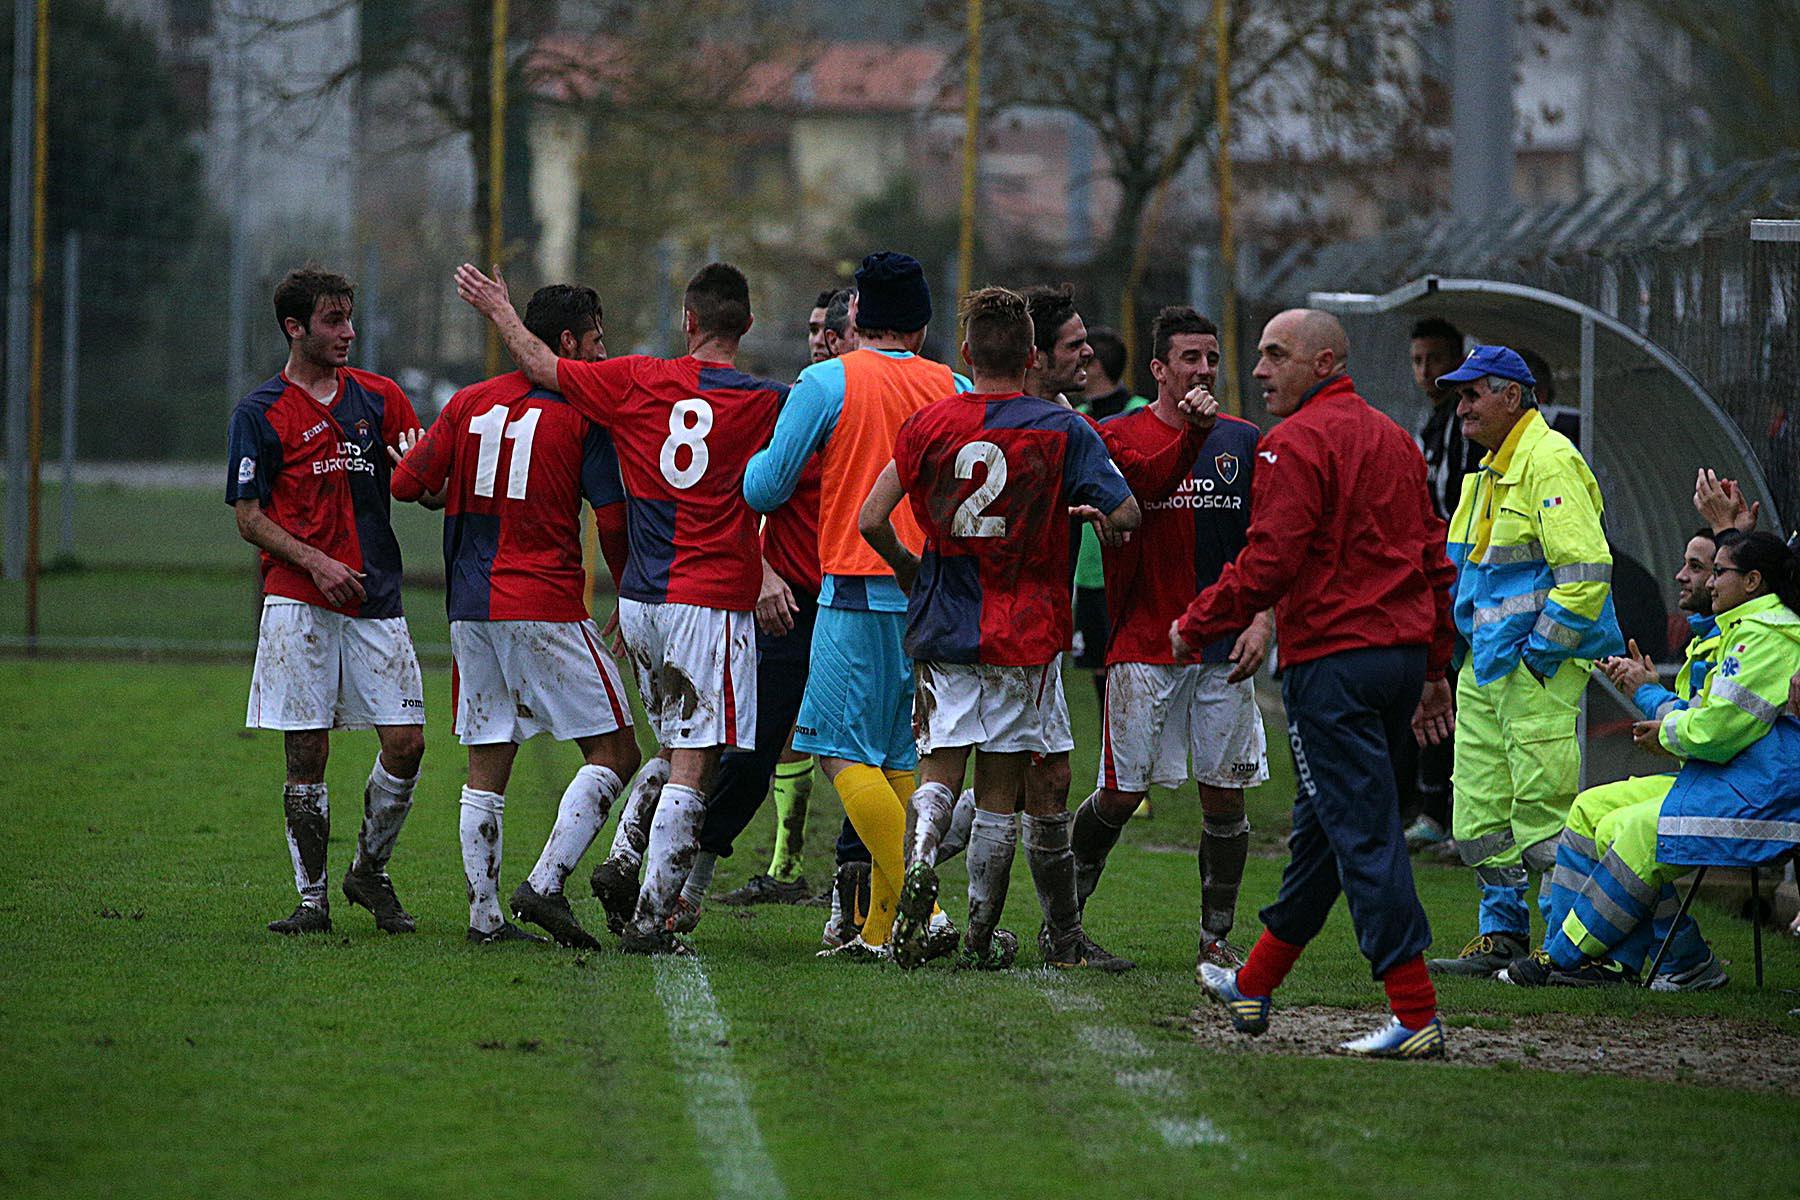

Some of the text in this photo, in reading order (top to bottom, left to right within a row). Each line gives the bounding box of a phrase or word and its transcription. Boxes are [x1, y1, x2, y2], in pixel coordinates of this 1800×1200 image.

[336, 441, 361, 456] UTO
[468, 403, 543, 500] 11
[659, 397, 714, 490] 8
[950, 440, 1008, 538] 2
